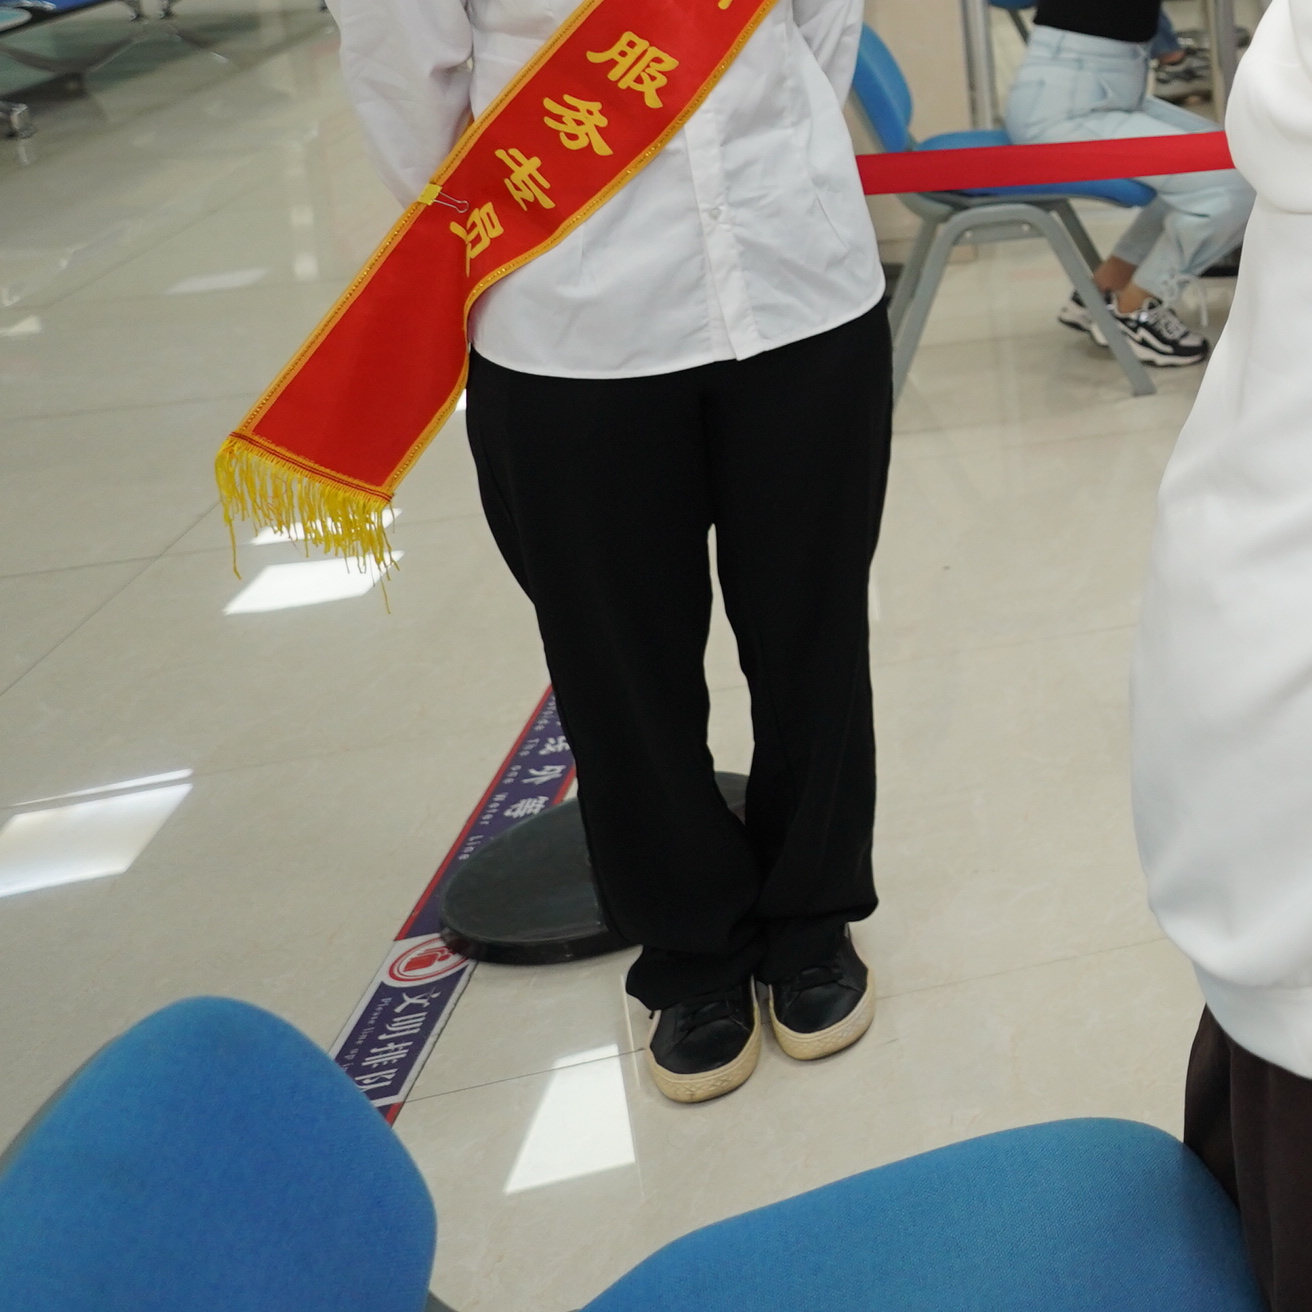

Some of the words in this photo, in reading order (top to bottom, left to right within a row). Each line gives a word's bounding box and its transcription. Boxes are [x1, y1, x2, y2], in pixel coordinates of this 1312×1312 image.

[449, 29, 681, 279] 服务专员
[354, 990, 442, 1093] 文明排队
